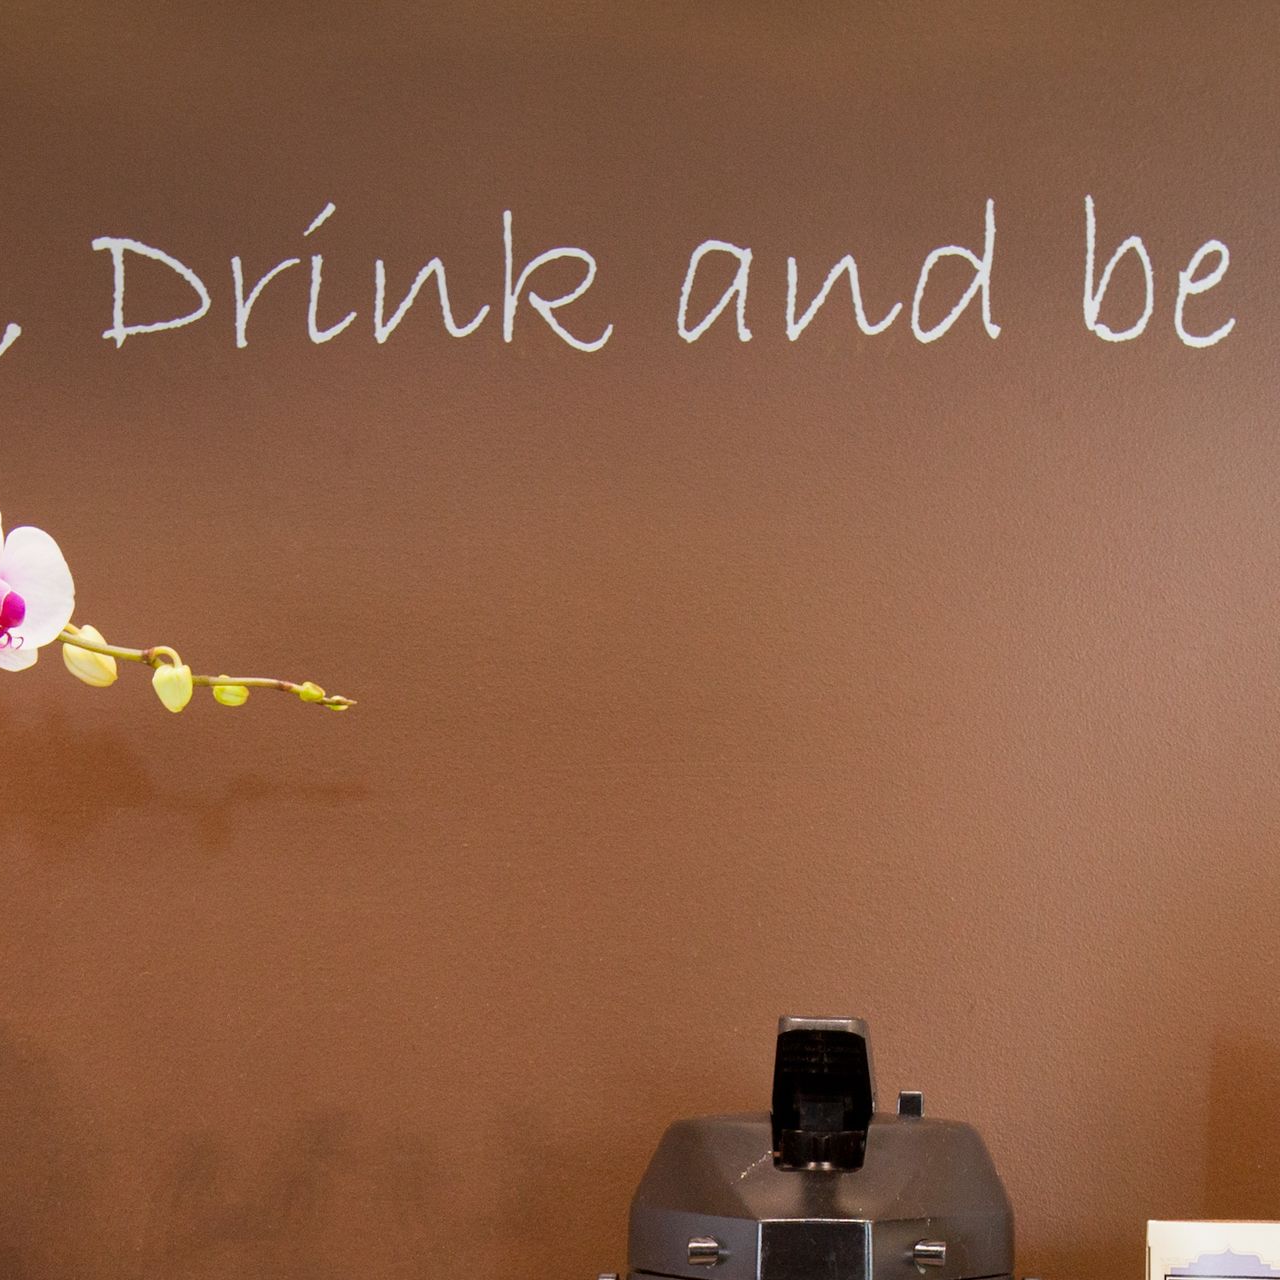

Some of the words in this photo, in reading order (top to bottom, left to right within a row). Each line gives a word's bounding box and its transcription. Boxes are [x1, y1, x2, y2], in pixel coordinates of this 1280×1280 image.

[91, 202, 613, 352] Drink
[678, 199, 1002, 342] and
[1083, 195, 1236, 347] be
